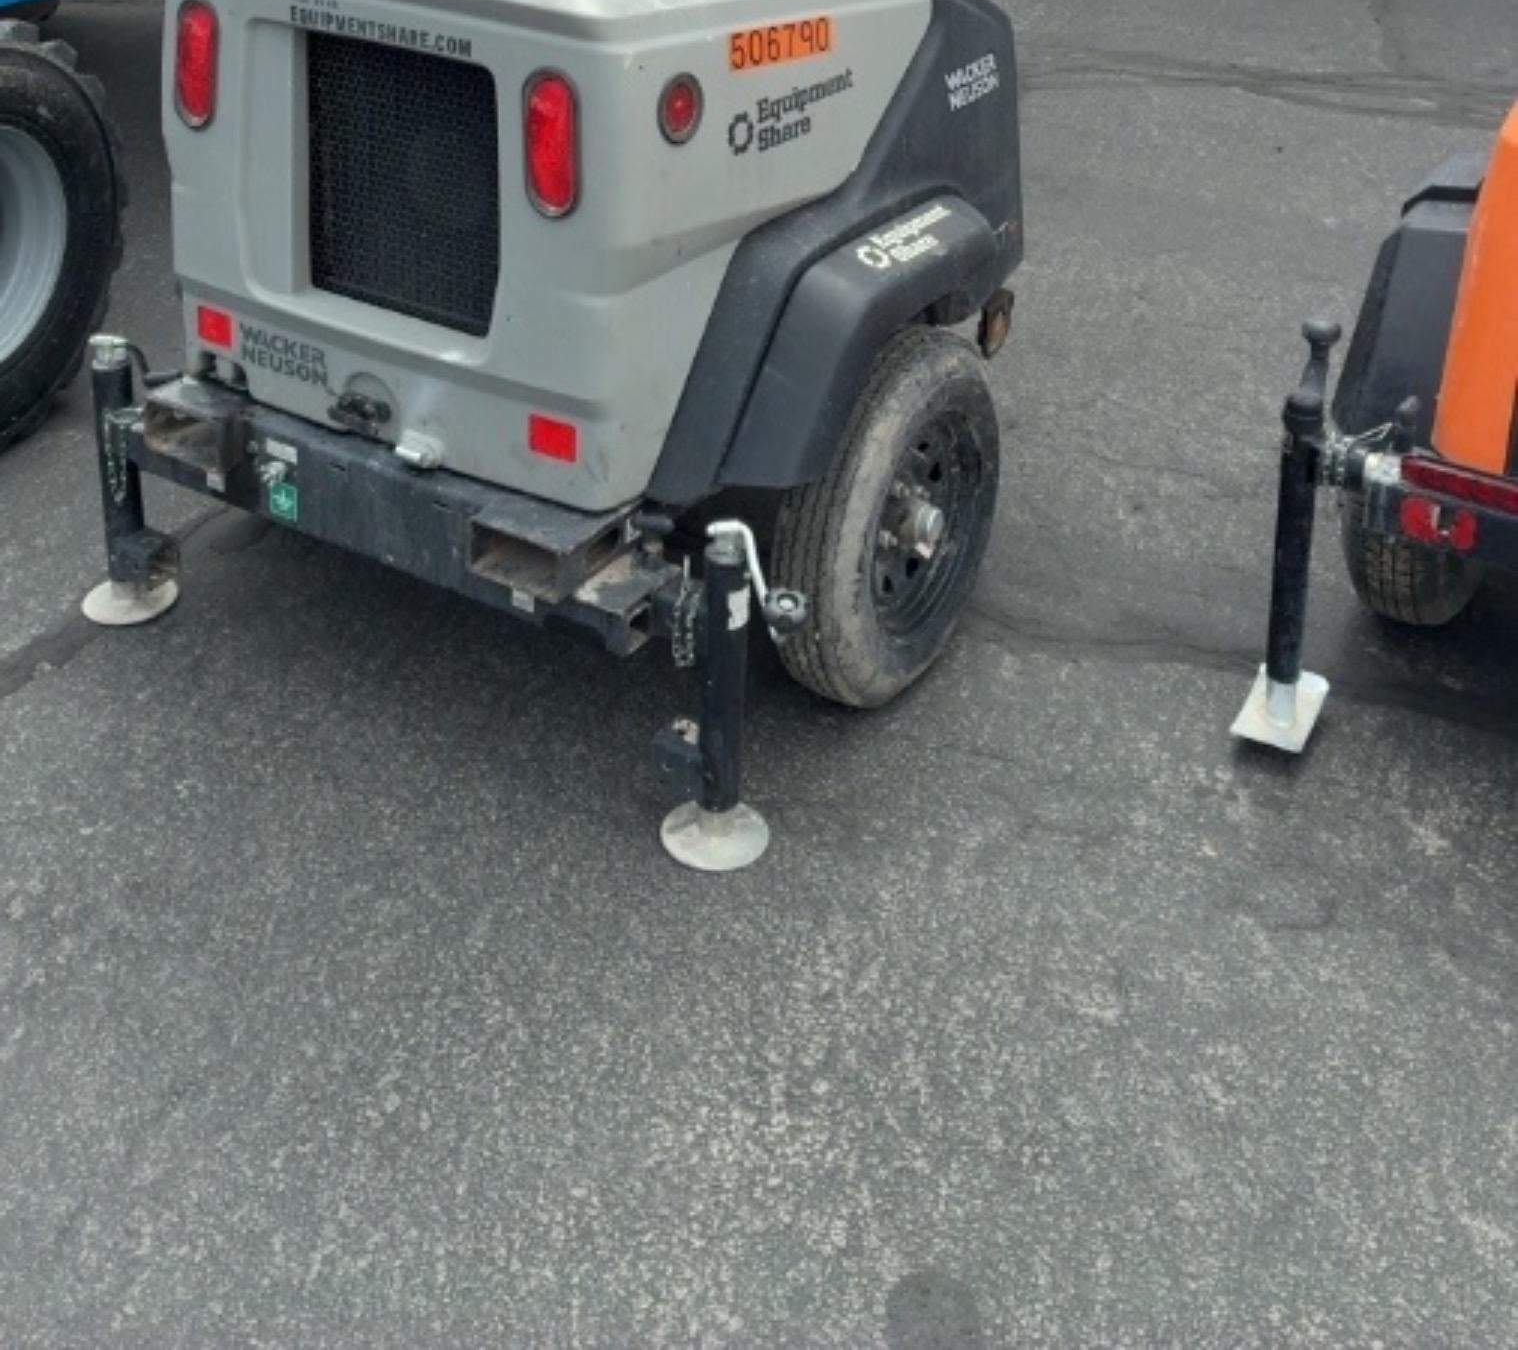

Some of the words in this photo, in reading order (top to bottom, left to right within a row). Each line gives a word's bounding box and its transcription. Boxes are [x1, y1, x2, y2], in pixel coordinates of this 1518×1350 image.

[290, 5, 472, 58] EQUIPMENTSHARE.COM
[730, 17, 830, 70] 506790
[756, 68, 854, 124] Equipment
[758, 116, 812, 152] Share
[240, 322, 328, 367] WACKER
[242, 346, 328, 388] NEUSON
